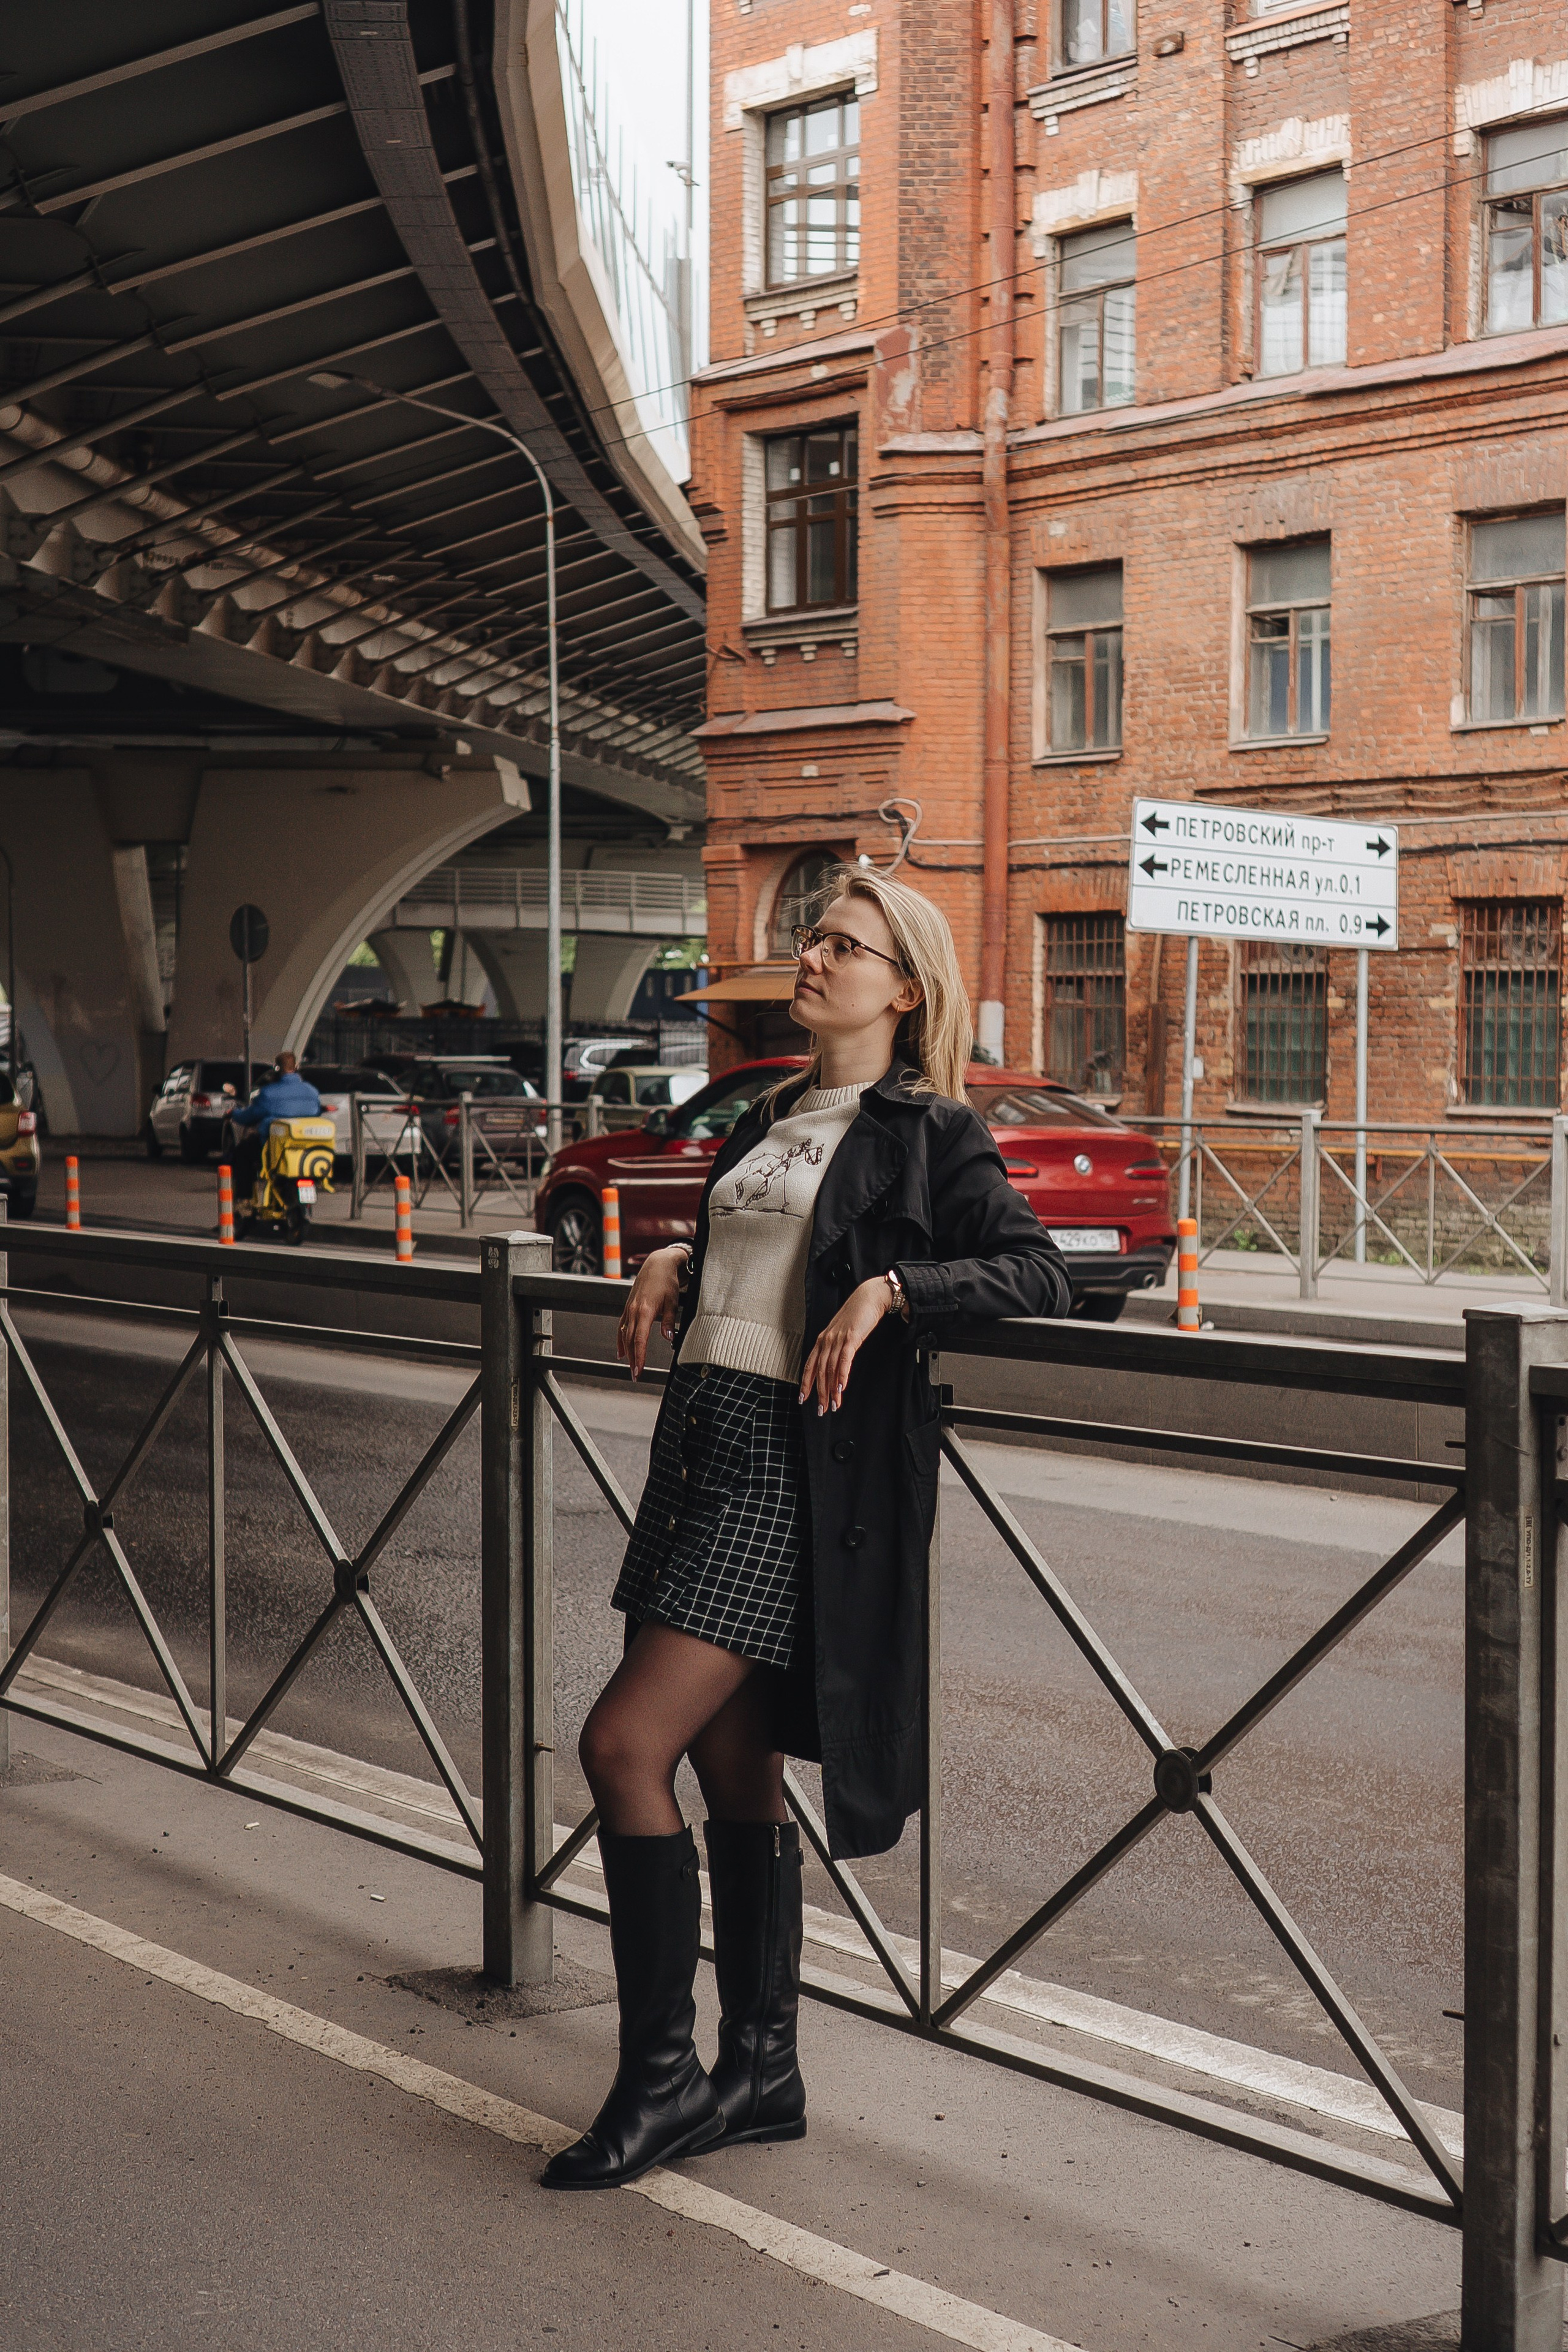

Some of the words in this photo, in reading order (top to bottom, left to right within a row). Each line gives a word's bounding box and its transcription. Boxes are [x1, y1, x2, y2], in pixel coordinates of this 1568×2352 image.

[1176, 815, 1295, 849] ПЕТРОВСКИЙ
[1302, 834, 1335, 855] пр-т
[1170, 858, 1310, 889] РЕМЕСЛЕННАЯ
[1177, 900, 1300, 930] ПЕТРОВСКАЯ
[1305, 916, 1330, 932] пл.
